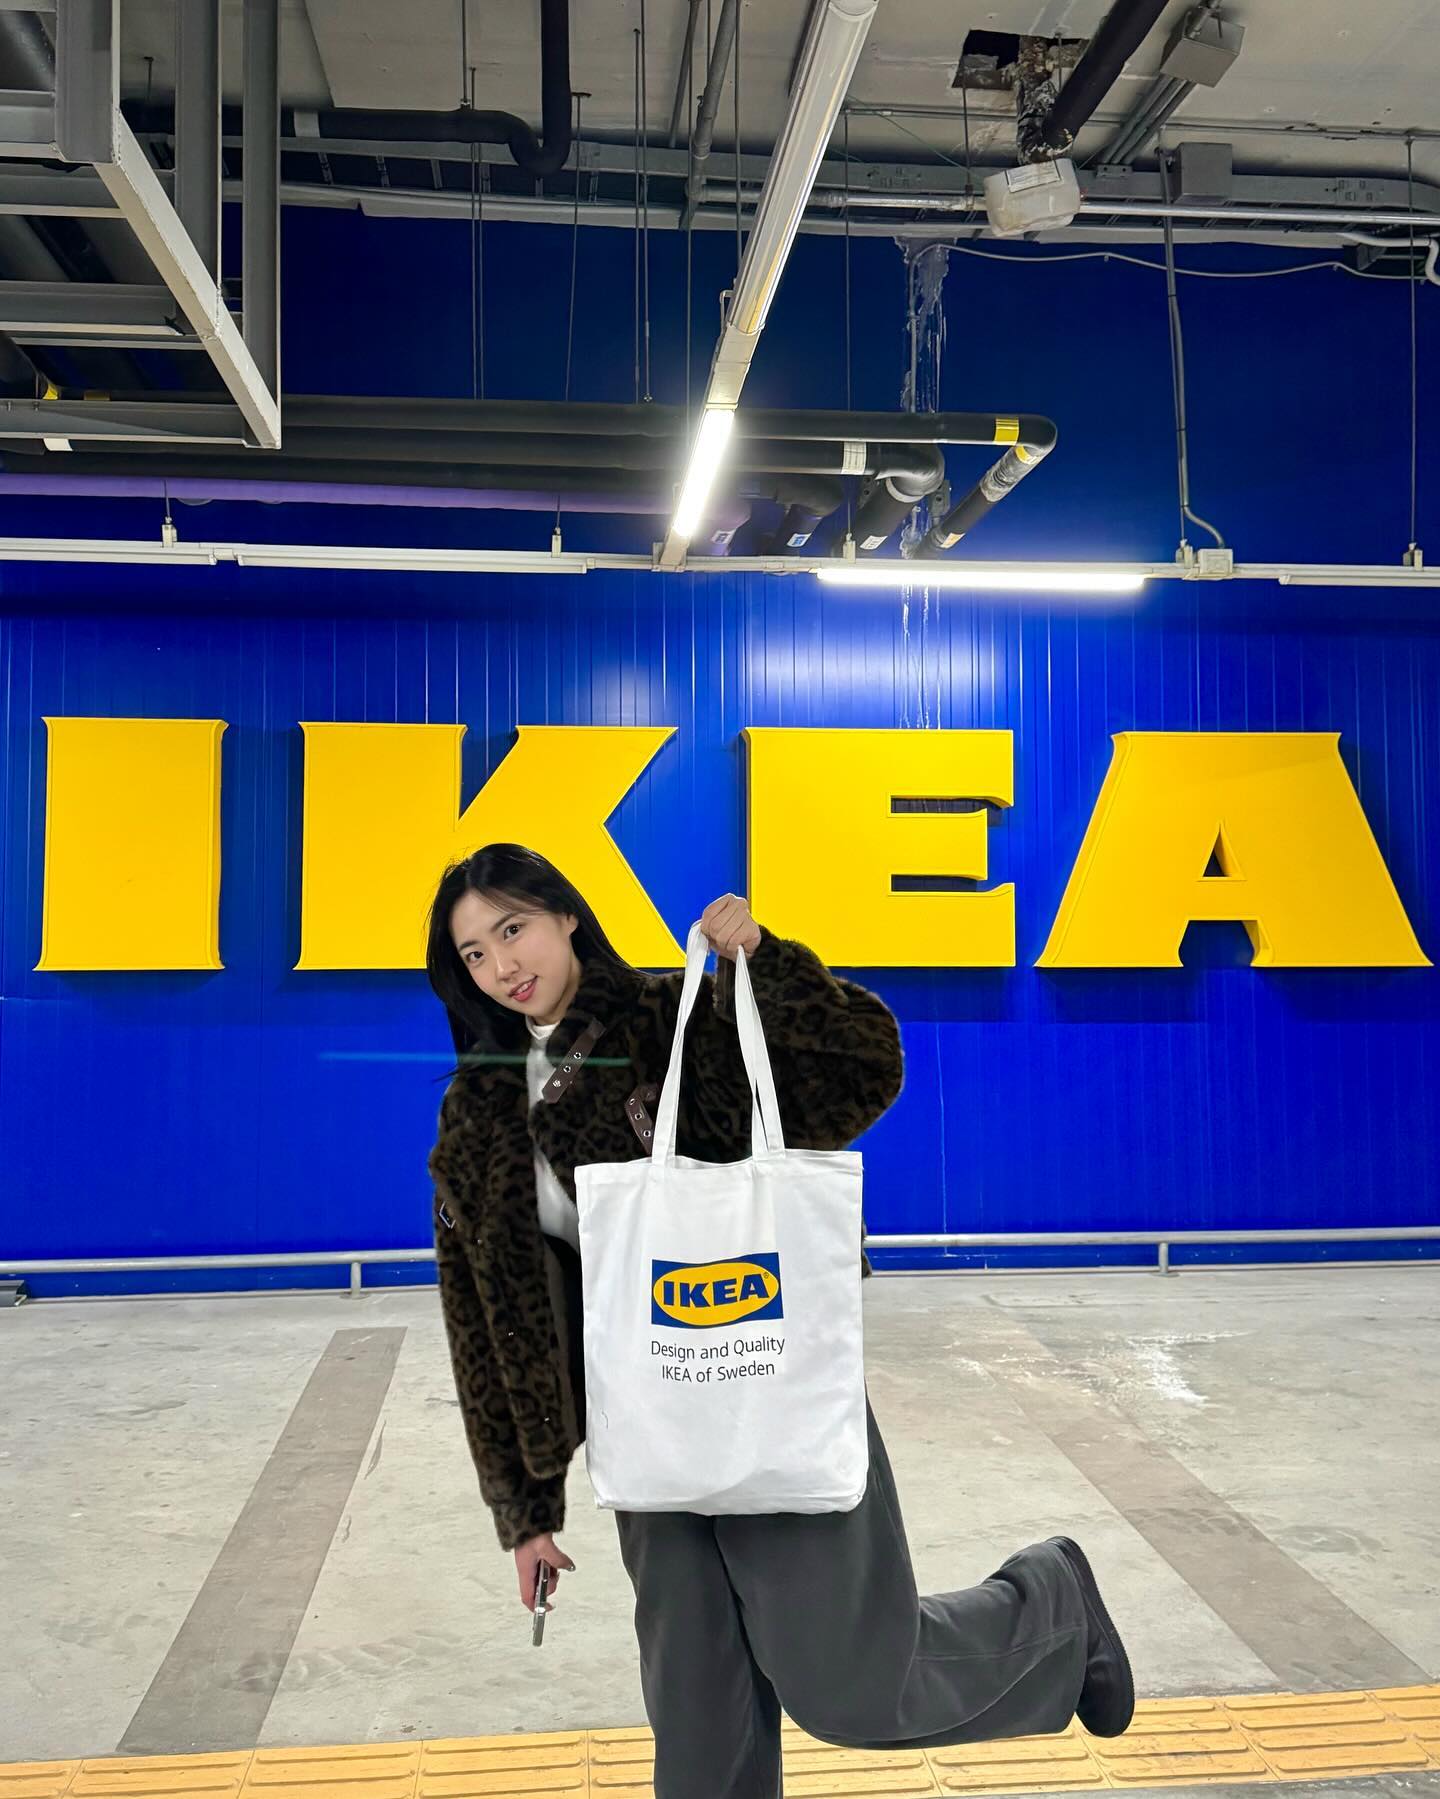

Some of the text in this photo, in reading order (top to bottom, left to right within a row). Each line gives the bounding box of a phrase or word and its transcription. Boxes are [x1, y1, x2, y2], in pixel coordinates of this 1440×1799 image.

[33, 717, 1433, 972] IKEA
[663, 1273, 769, 1308] IKEA
[651, 1336, 785, 1363] Design and Quality
[662, 1360, 775, 1383] IKEA of Sweden
